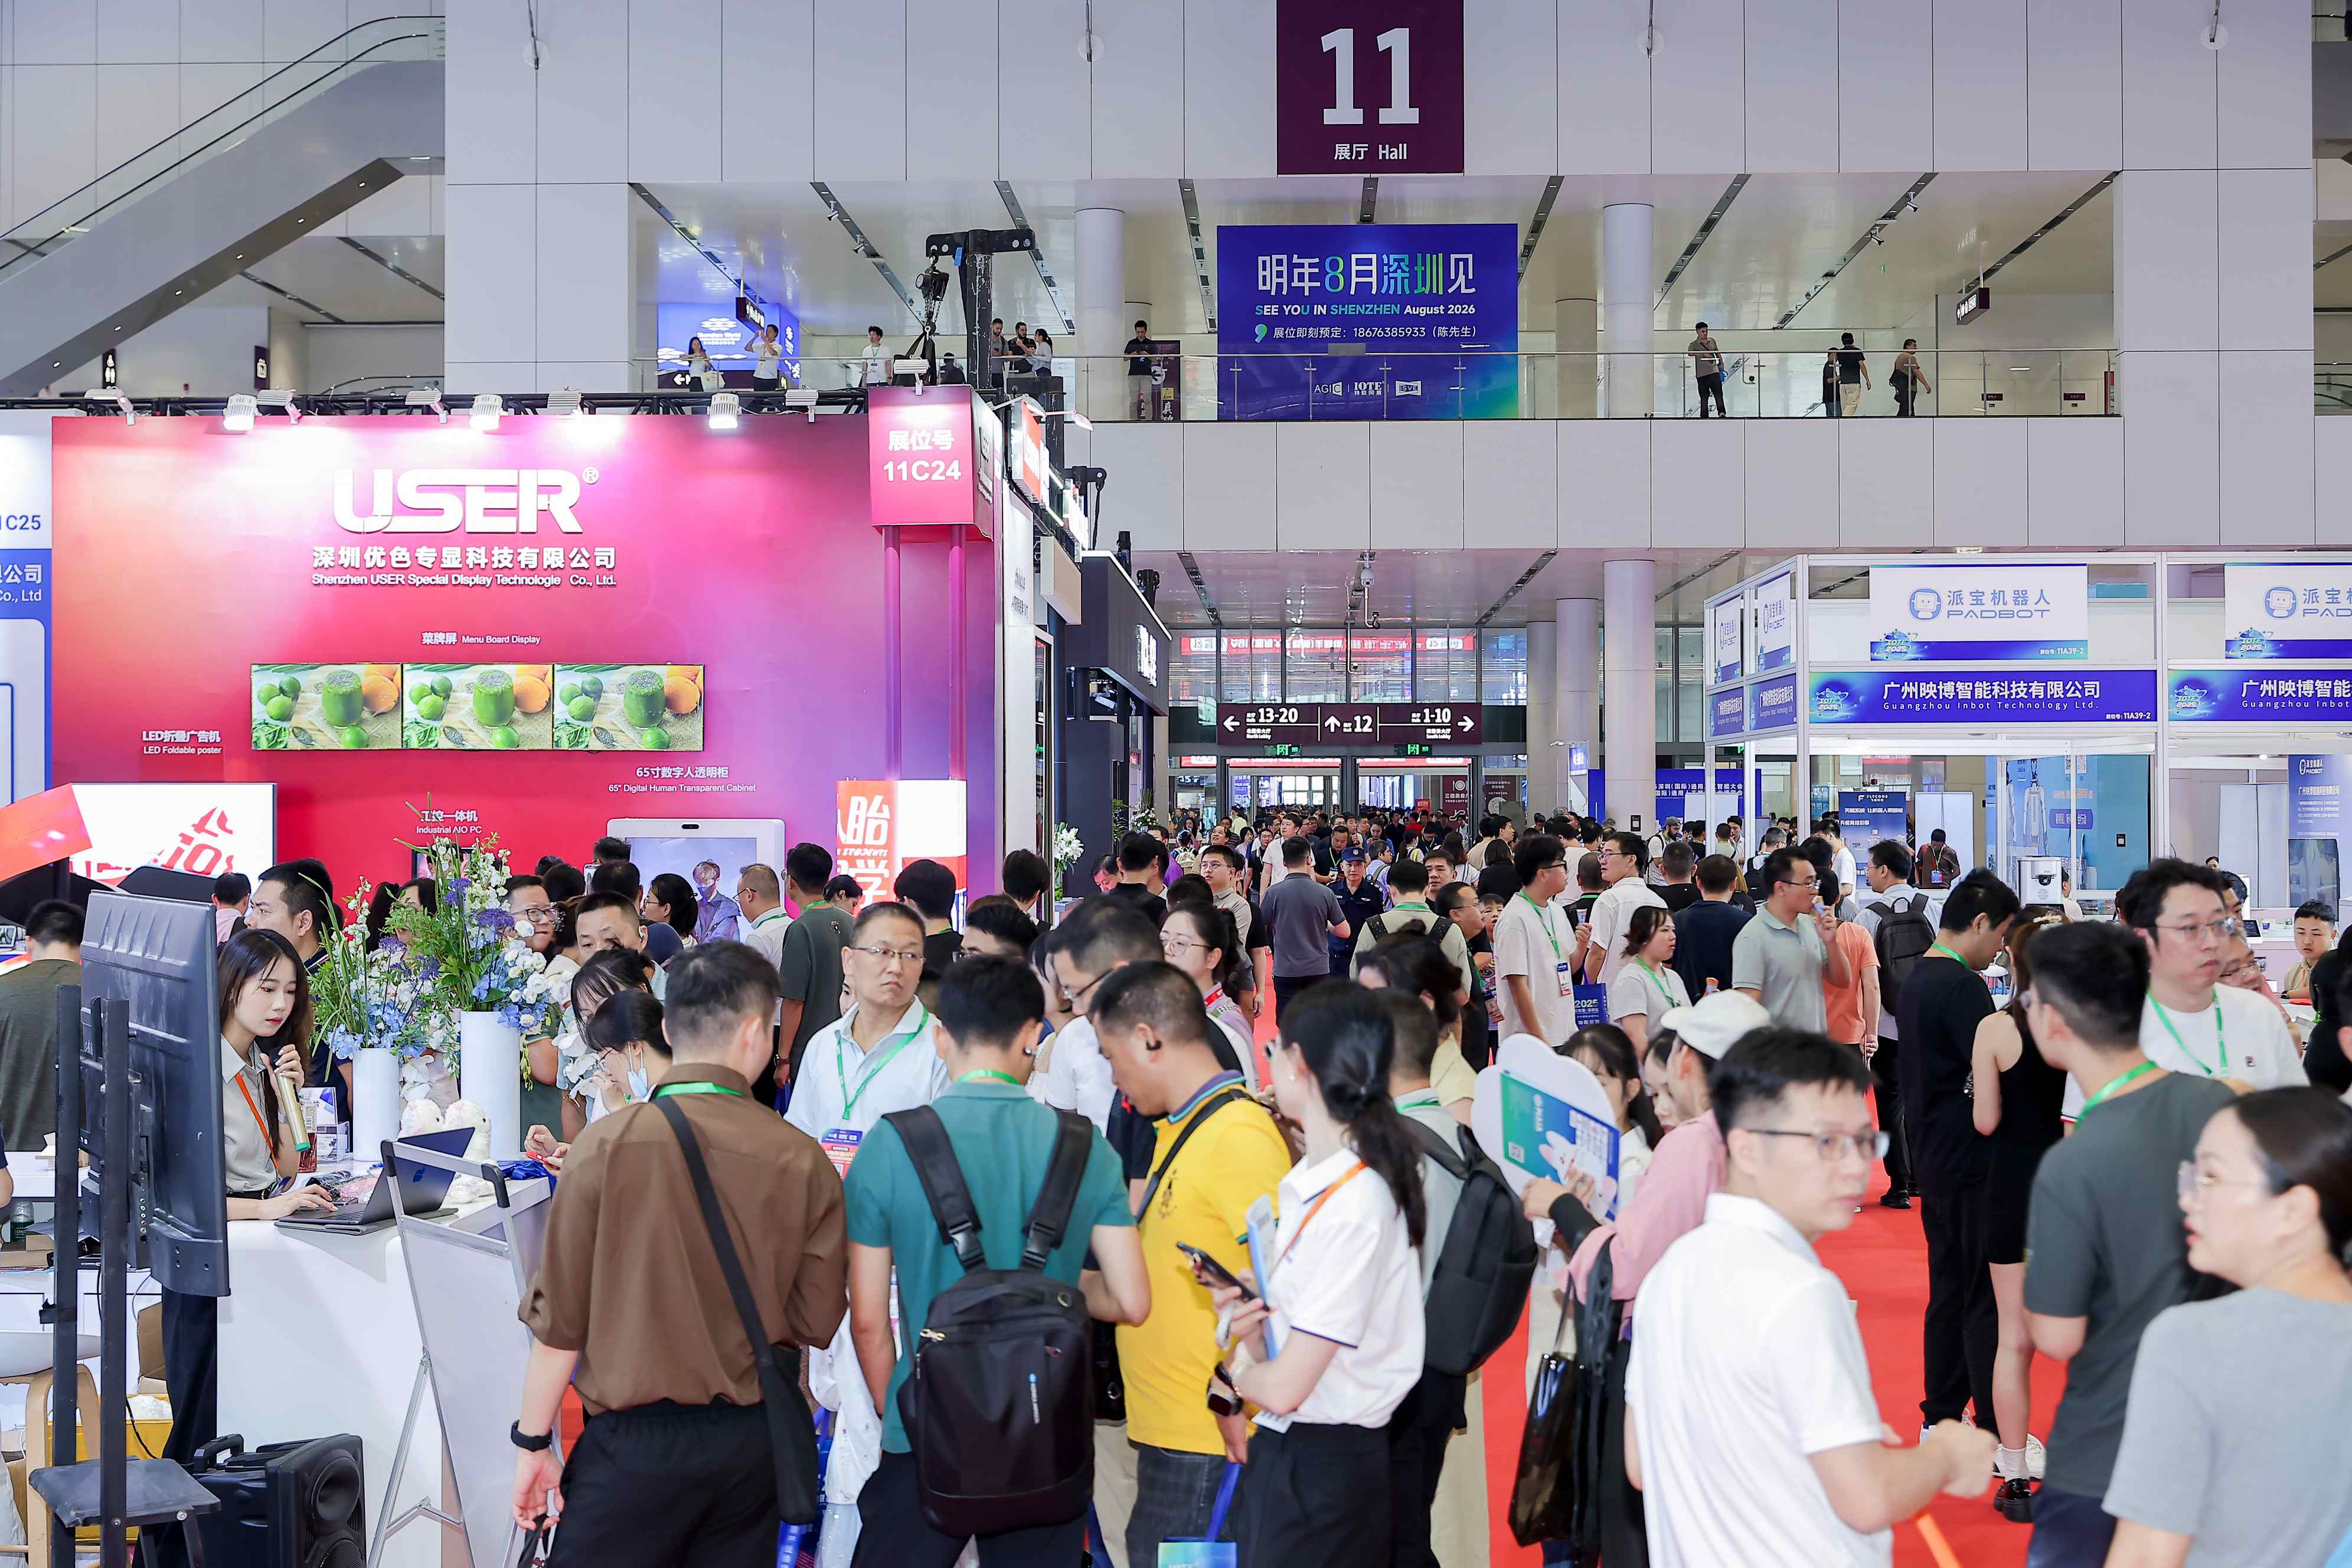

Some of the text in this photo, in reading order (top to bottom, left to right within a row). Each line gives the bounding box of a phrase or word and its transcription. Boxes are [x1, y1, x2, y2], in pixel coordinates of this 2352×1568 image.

[1321, 28, 1419, 125] 11
[1334, 143, 1407, 160] 展厅 Hall
[1257, 253, 1476, 296] 明年8月深圳见
[1255, 304, 1475, 316] SEE YOU IN SHENZHEN August 2026
[1353, 327, 1426, 337] 18676385933
[1354, 382, 1382, 390] IOTE
[888, 429, 954, 451] 展位号
[883, 460, 962, 482] 11C24
[333, 469, 583, 534] USER
[312, 546, 616, 570] 深圳优色专显科技有限公司
[0, 564, 43, 584] 公司
[312, 574, 368, 585] Shenzhen
[370, 574, 405, 585] USER
[407, 573, 449, 587] Special
[596, 574, 616, 586] Ltd.
[21, 589, 43, 602] Ltd
[1947, 589, 2050, 606] 派宝机器人
[1947, 609, 2050, 619] PADBOT
[422, 632, 541, 646] 菜牌屏 Menu Board Display
[1883, 681, 2101, 700] 广州映博智能科技有限公司
[2241, 679, 2352, 698] 广州映博智能
[1883, 700, 2099, 711] Guangzhou Inbot Technology Ltd.
[2242, 700, 2309, 710] Guangzhou
[1258, 708, 1298, 723] 13-20
[1423, 708, 1451, 723] 1-10
[1354, 715, 1373, 732] 12
[197, 747, 222, 755] poster
[636, 766, 729, 779] 65寸数字人透明柜
[623, 785, 647, 793] Digital
[679, 785, 724, 793] Transparent
[420, 810, 478, 822] 工控一体机
